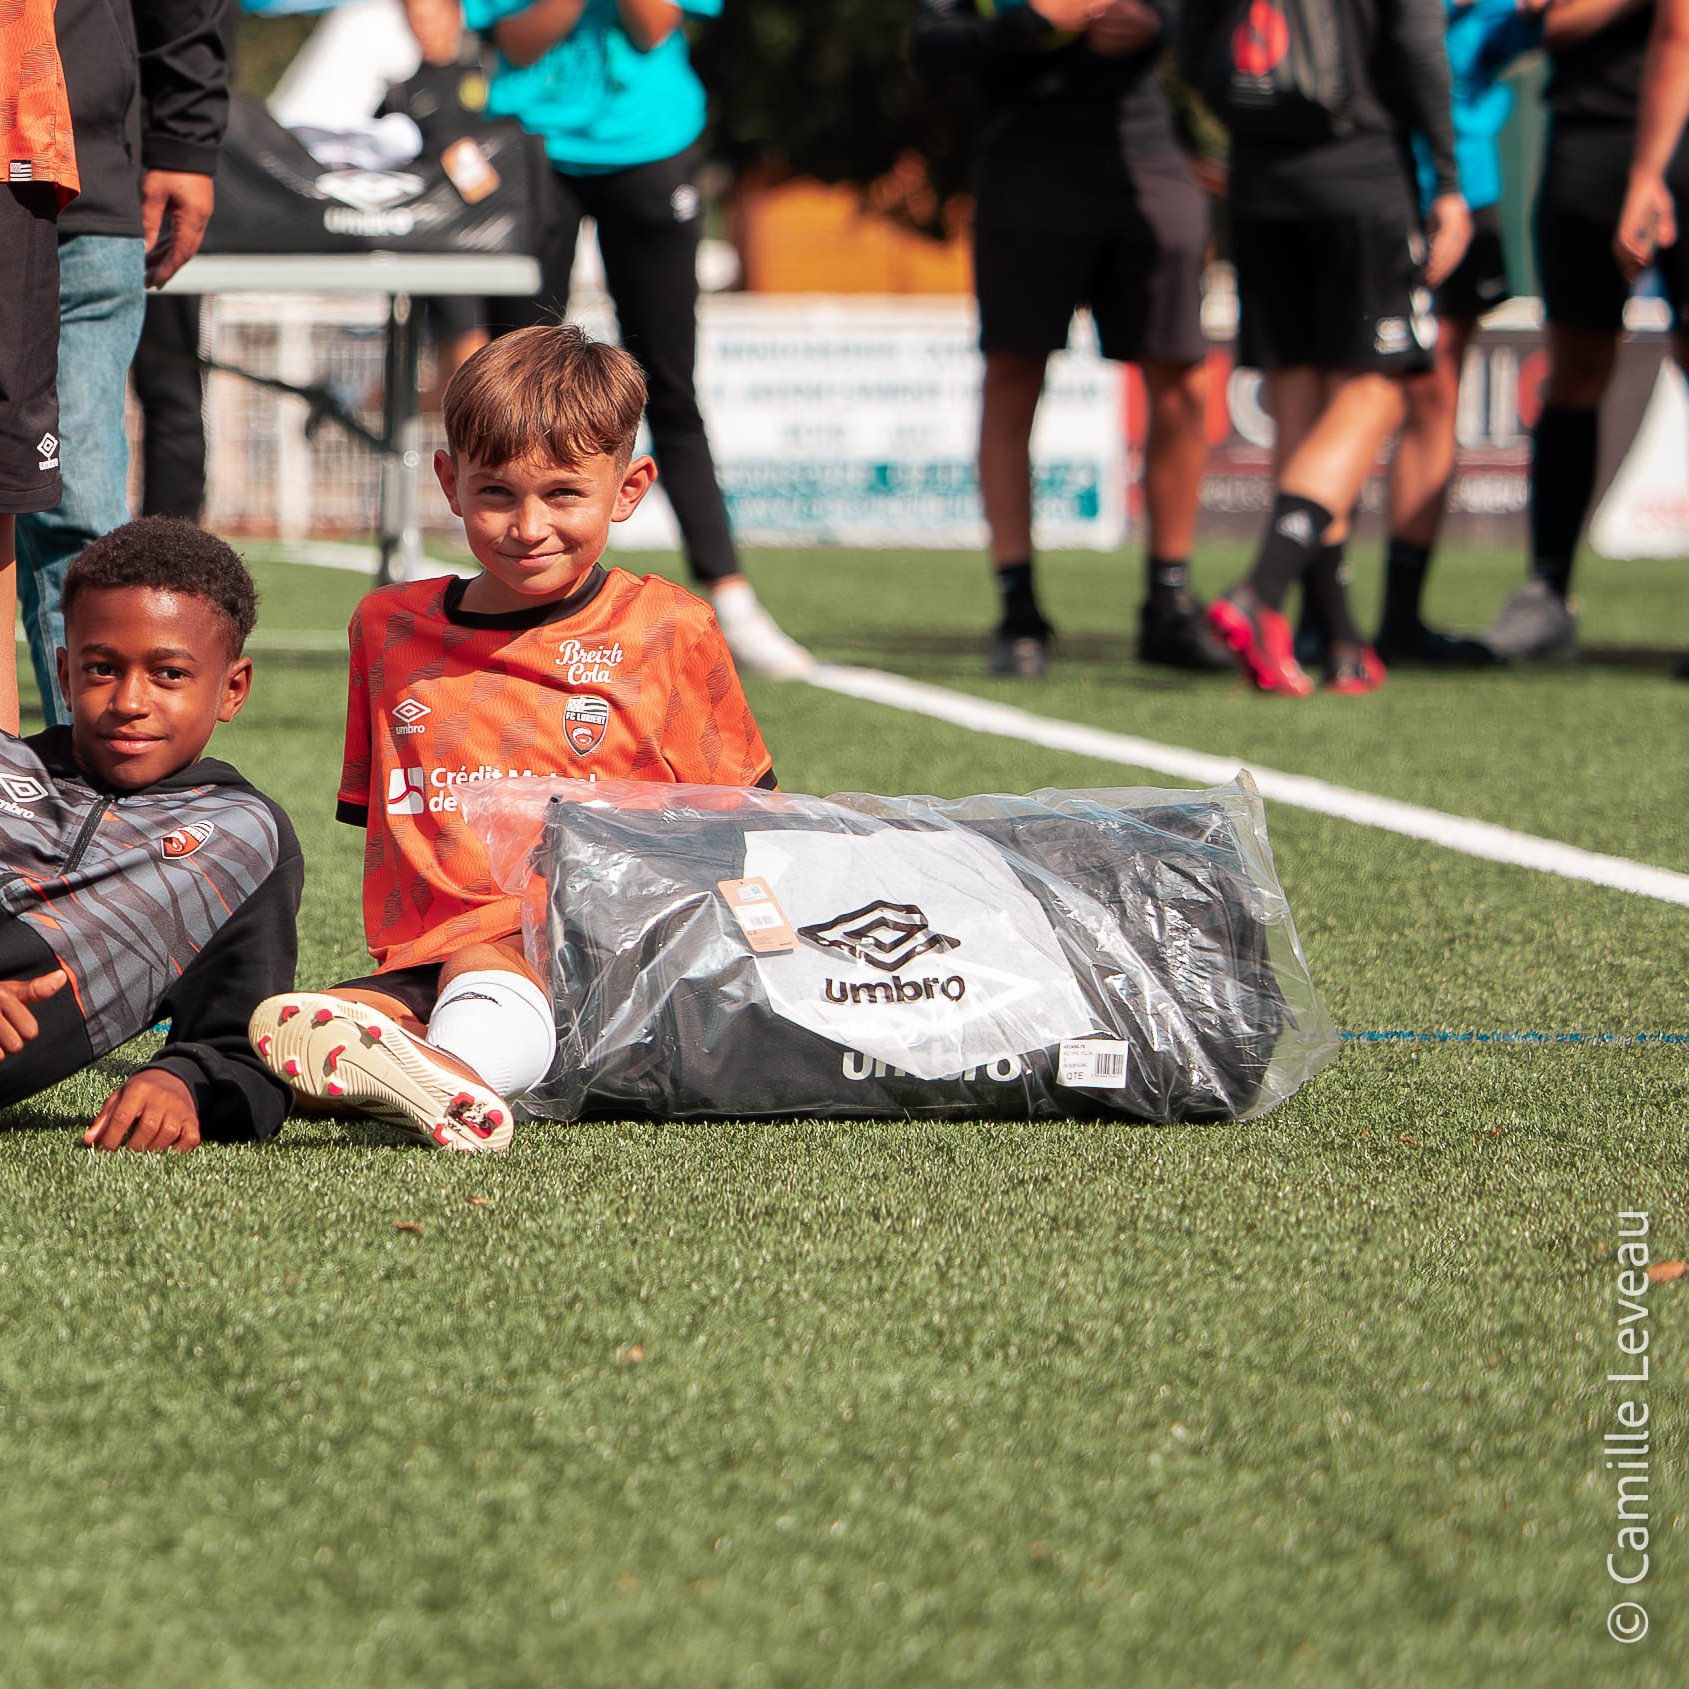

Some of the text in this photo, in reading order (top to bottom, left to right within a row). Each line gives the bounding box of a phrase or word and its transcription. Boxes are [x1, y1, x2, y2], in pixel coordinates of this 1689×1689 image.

[555, 639, 623, 667] Breizh
[567, 663, 611, 685] Cola
[396, 722, 425, 735] umbro
[566, 711, 605, 725] FC LORIENT
[429, 791, 458, 812] de
[825, 975, 965, 1004] umbro
